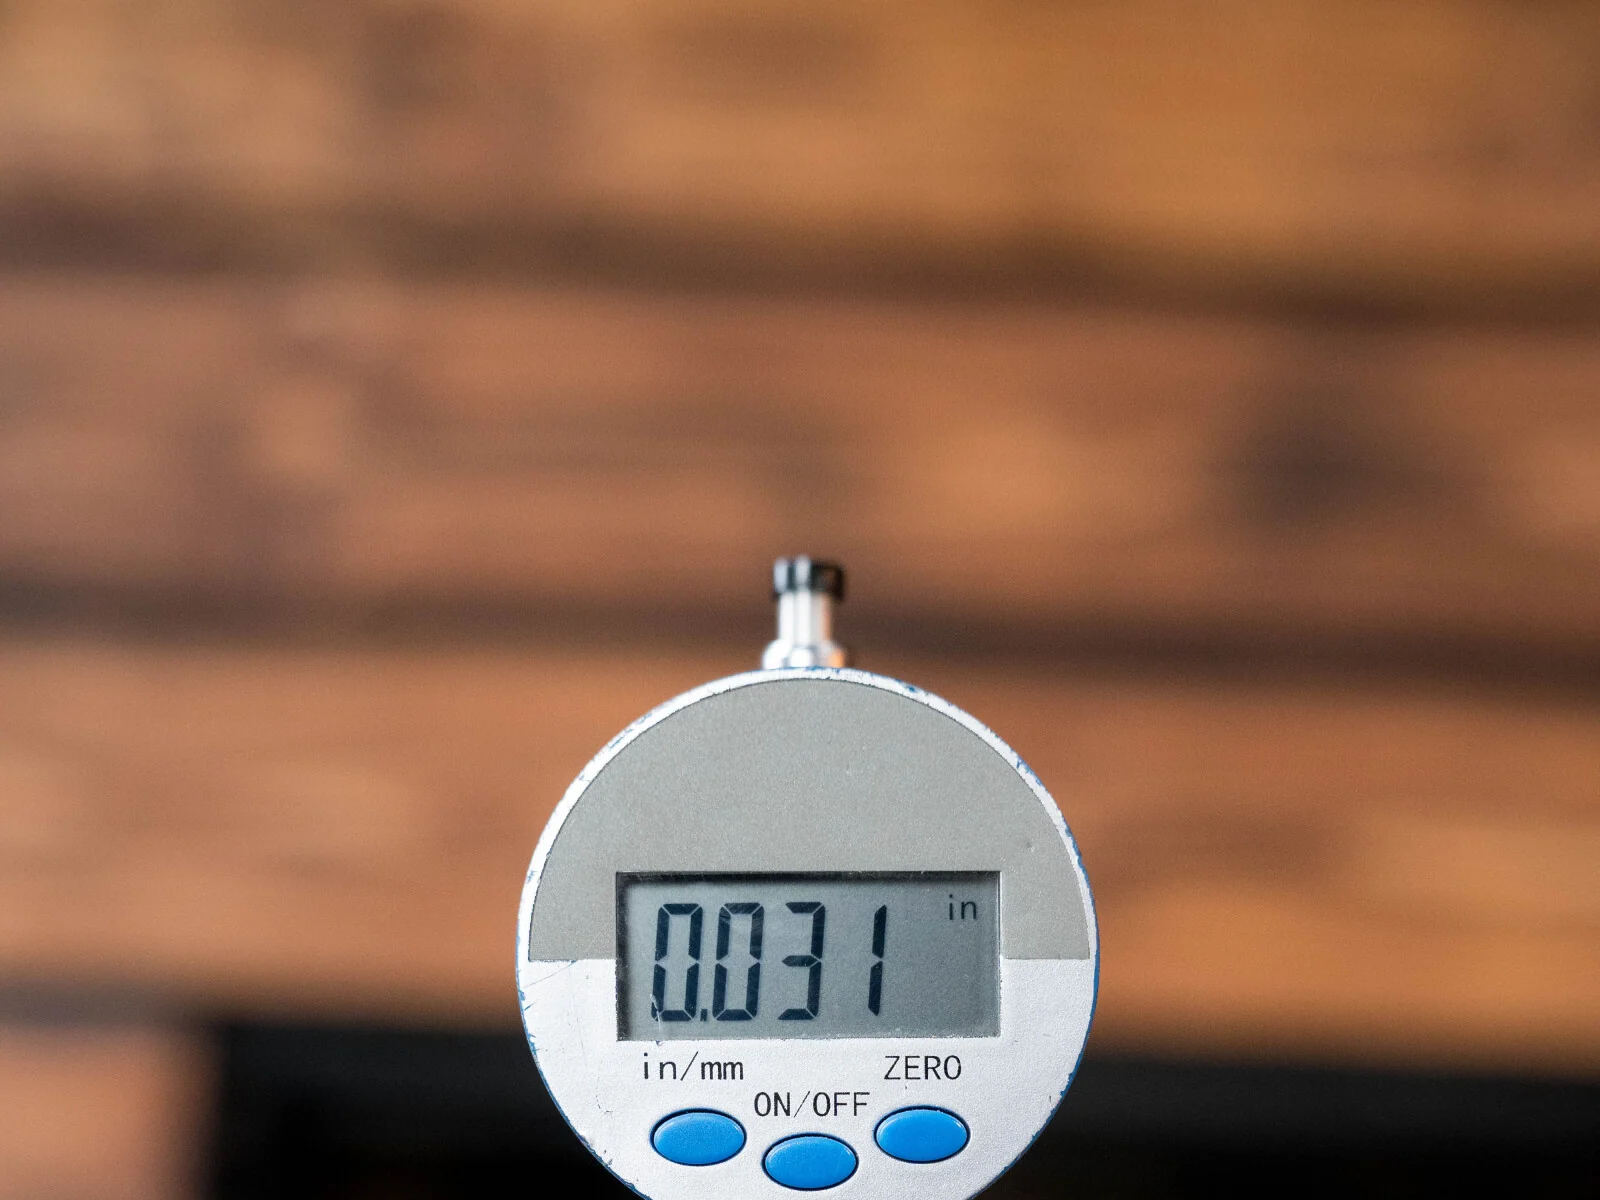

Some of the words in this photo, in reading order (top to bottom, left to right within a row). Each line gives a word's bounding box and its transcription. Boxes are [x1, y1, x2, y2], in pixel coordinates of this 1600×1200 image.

[651, 901, 887, 1022] 0.031
[948, 894, 977, 920] in
[643, 1052, 744, 1081] in/mm
[884, 1055, 962, 1080] ZERO
[754, 1091, 870, 1117] ON/OFF
